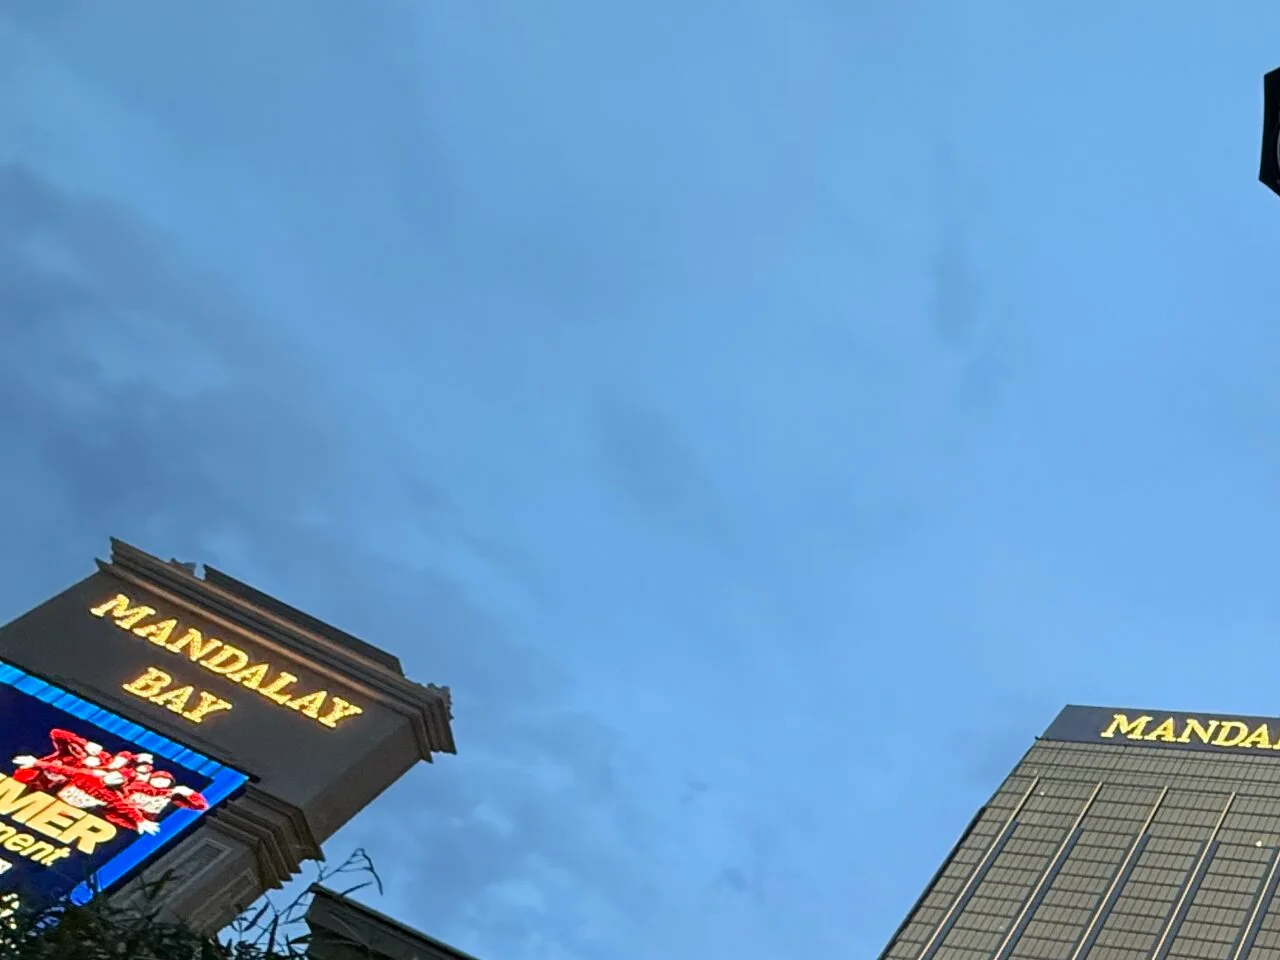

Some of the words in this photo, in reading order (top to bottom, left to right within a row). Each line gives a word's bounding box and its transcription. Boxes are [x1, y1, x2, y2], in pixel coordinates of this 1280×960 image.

[90, 592, 363, 729] MANDALAY
[122, 667, 233, 724] BAY
[0, 773, 118, 854] MER
